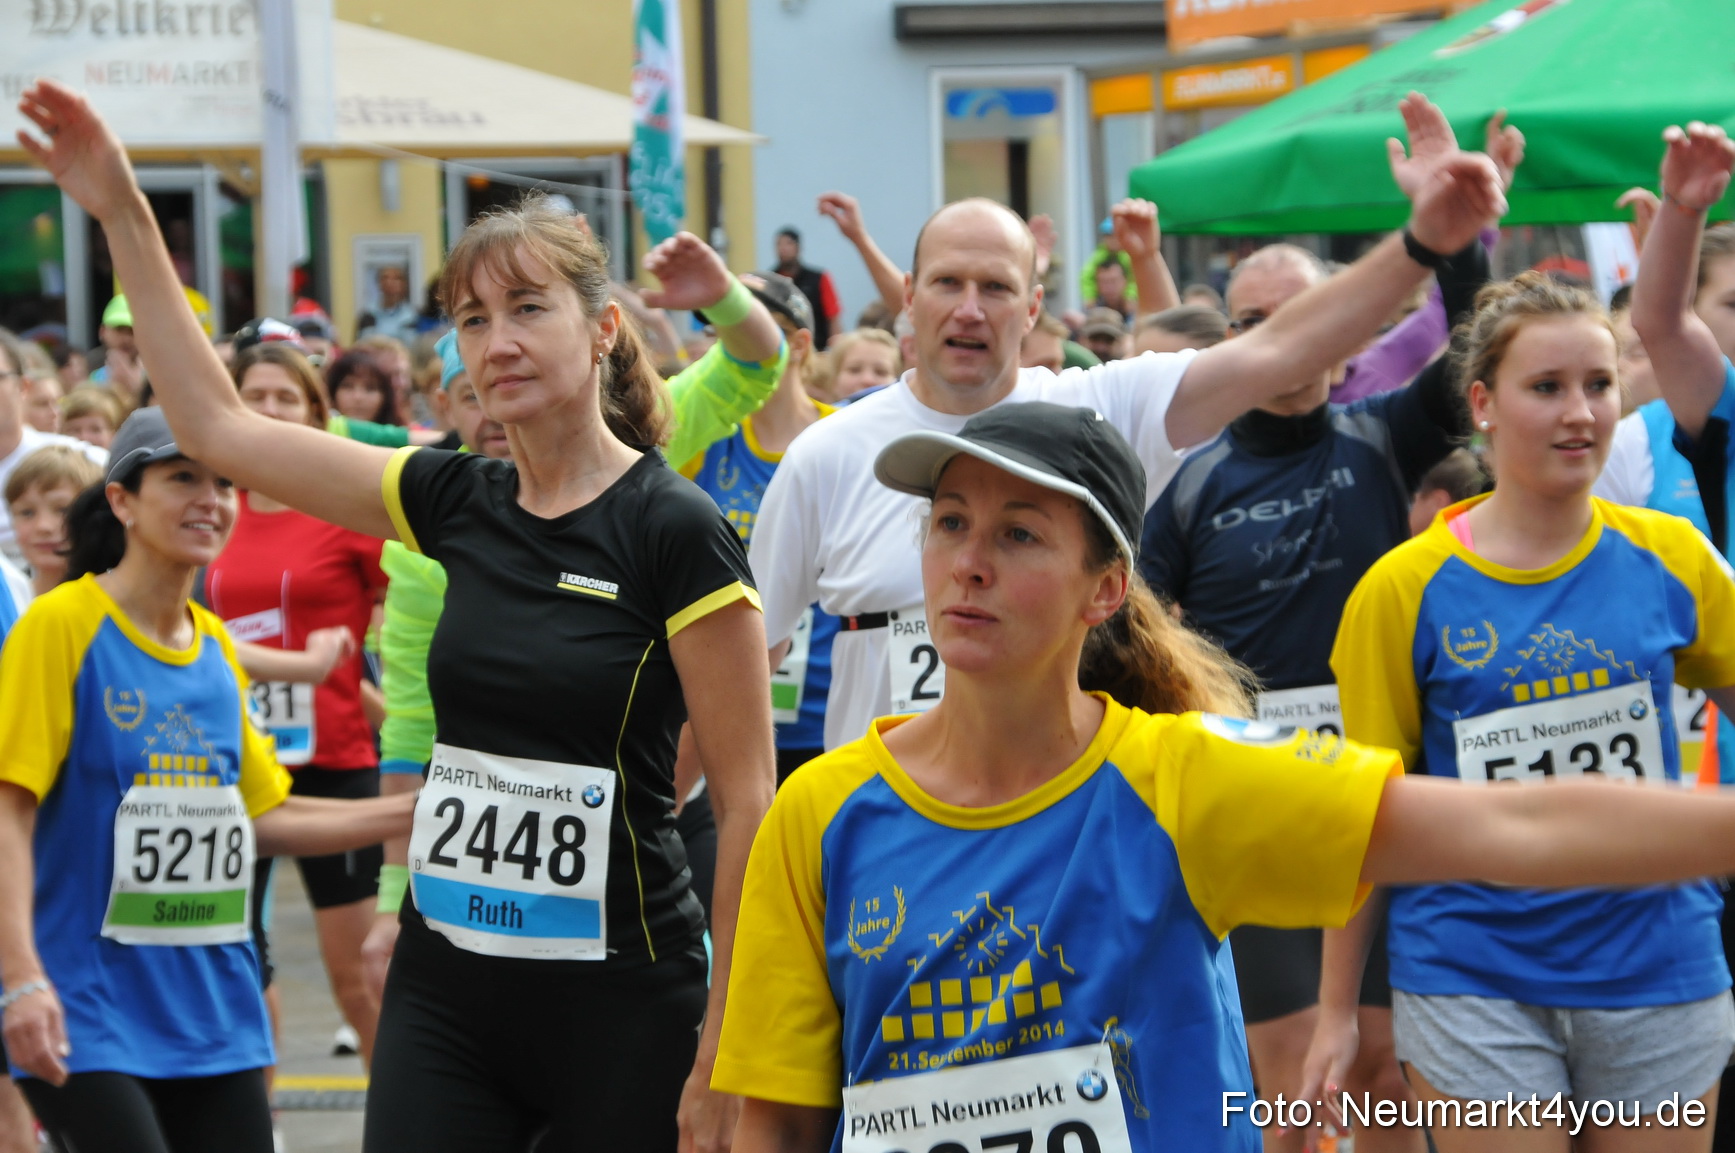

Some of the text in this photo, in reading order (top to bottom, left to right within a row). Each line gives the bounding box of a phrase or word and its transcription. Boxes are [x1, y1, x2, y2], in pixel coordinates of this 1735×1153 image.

[26, 0, 262, 35] Weltkrie
[1455, 640, 1488, 653] Jahre
[1263, 703, 1315, 719] PARTL
[1463, 709, 1623, 752] PARTL Neumarkt
[432, 765, 483, 789] PARTL
[487, 777, 573, 802] Neumarkt
[119, 803, 237, 818] PARTL Neumarkt
[132, 827, 243, 883] 5218
[427, 797, 586, 886] 2448
[153, 899, 216, 922] Sabine
[468, 895, 523, 928] Ruth
[865, 897, 880, 914] 15
[855, 915, 890, 937] Jahre
[1019, 1020, 1065, 1045] 2014
[851, 1106, 926, 1138] PARTL
[932, 1082, 1067, 1124] Neumarkt
